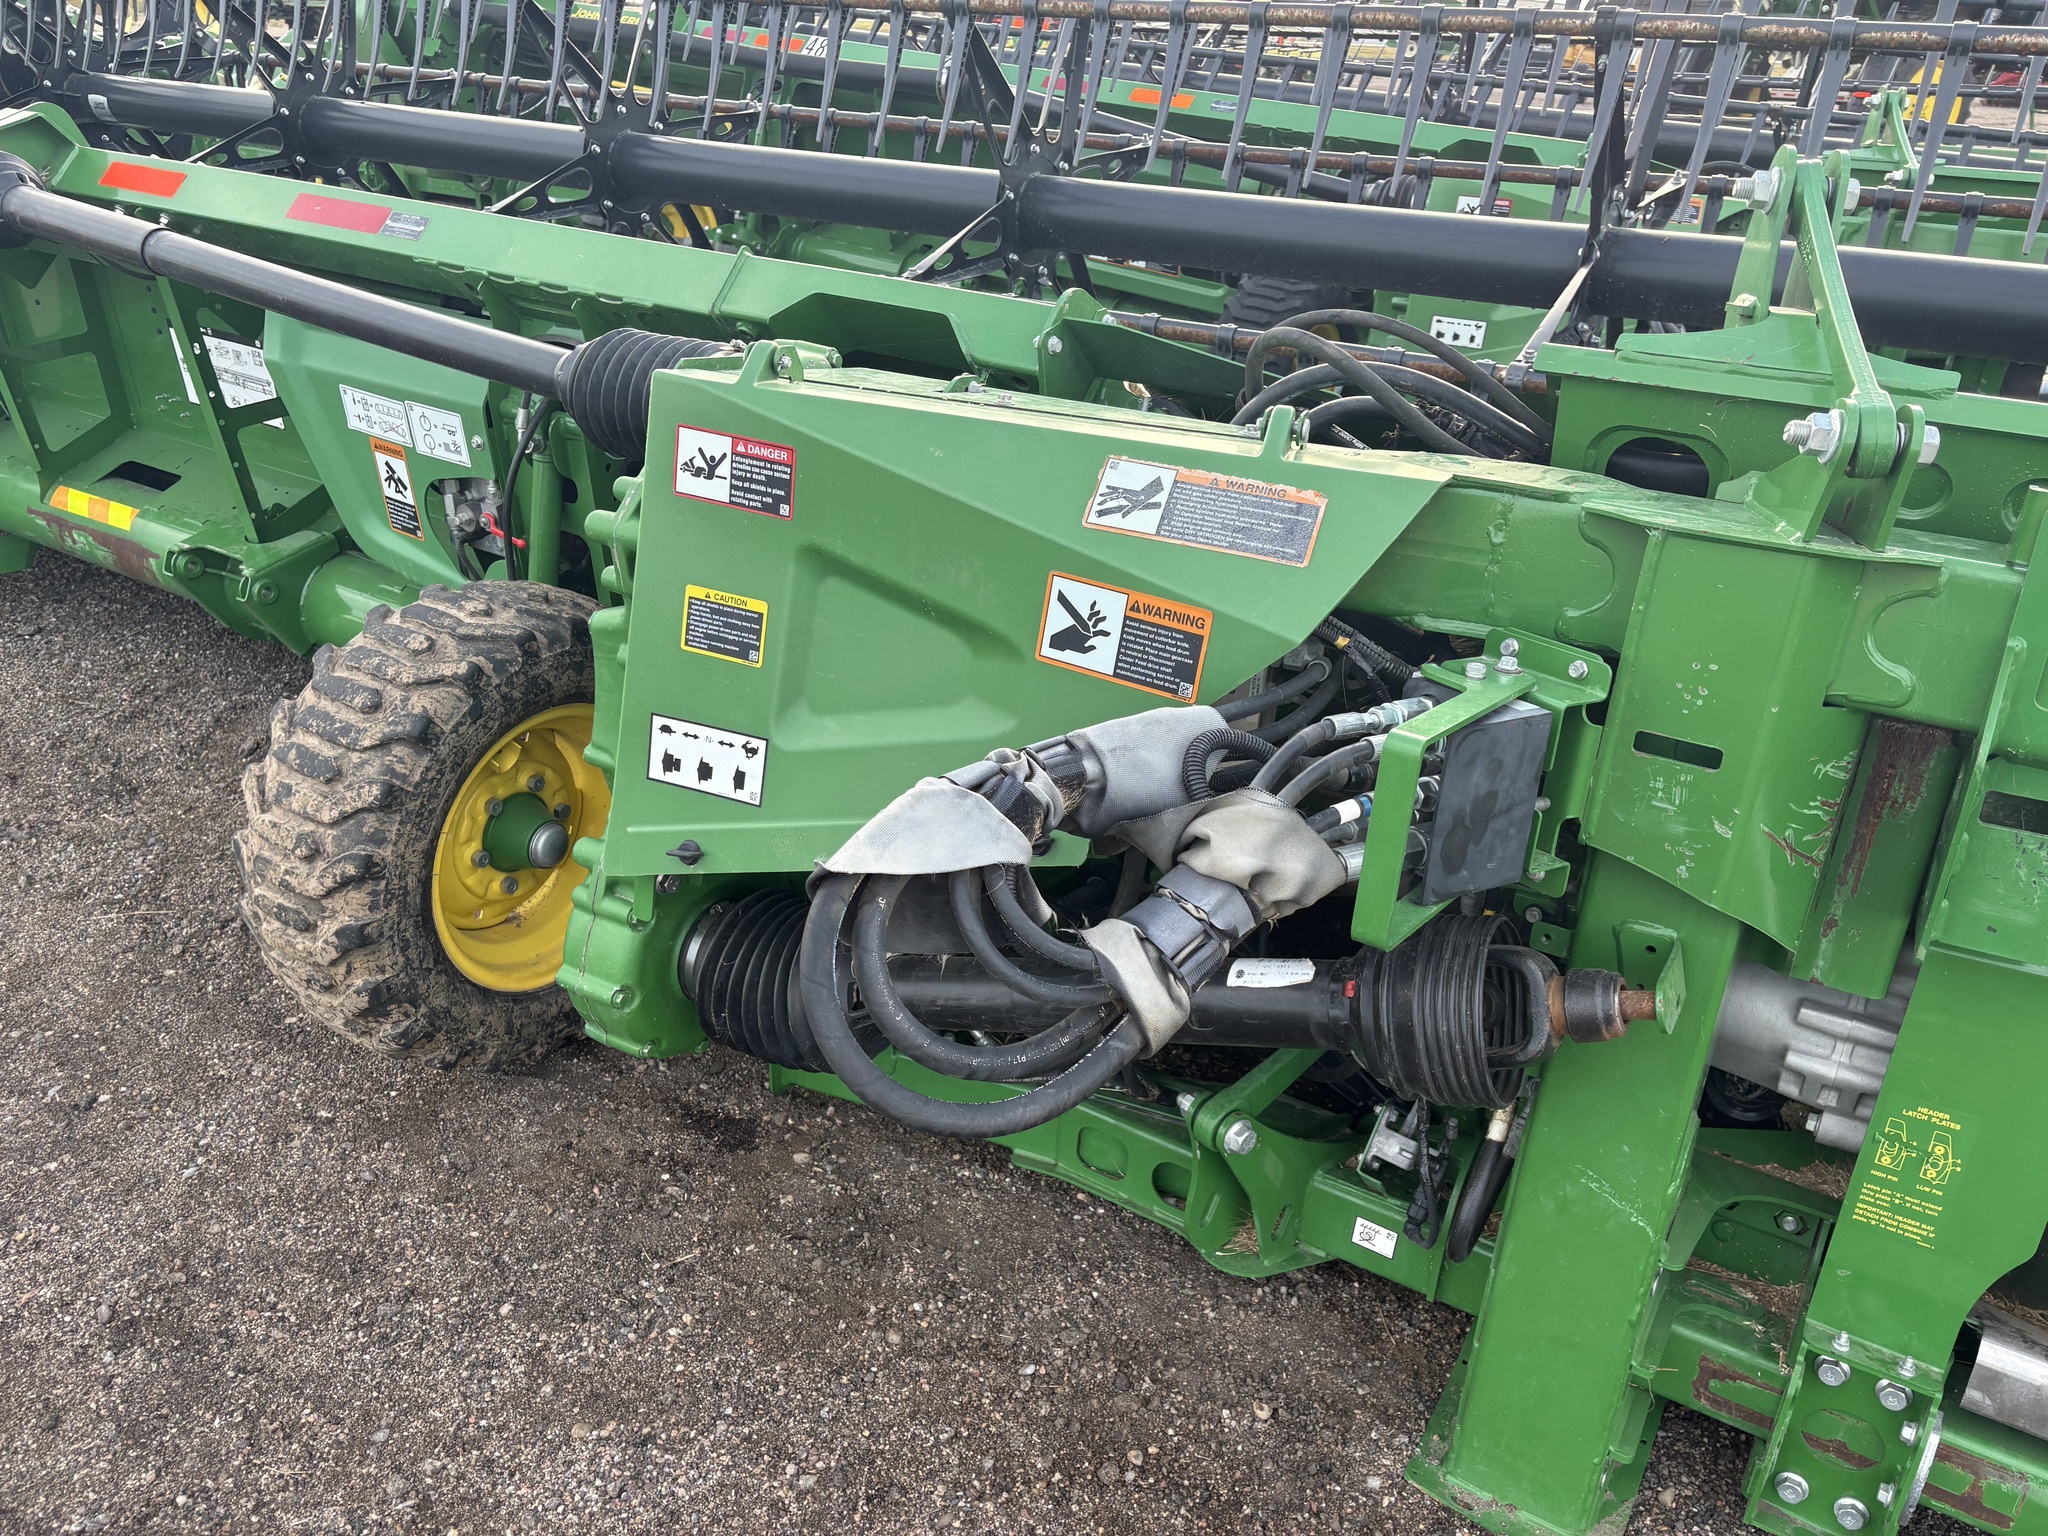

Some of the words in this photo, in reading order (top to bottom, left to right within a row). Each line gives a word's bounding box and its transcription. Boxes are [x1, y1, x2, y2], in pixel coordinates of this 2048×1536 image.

[747, 444, 788, 461] DANGER
[732, 462, 751, 471] driveline
[733, 455, 765, 467] Entanglement
[772, 464, 790, 474] rotating
[732, 469, 745, 477] injury
[752, 473, 767, 481] death.
[732, 479, 743, 487] Keep
[750, 483, 766, 491] shields
[772, 488, 786, 496] place.
[1226, 479, 1288, 499] WARNING
[731, 489, 744, 497] Avoid
[745, 493, 762, 501] contact
[731, 497, 748, 506] rotating
[714, 593, 748, 607] CAUTION
[1143, 603, 1205, 629] WARNING
[1124, 627, 1148, 637] movement
[1155, 636, 1176, 644] cutterbar
[1140, 624, 1157, 632] serious
[1158, 629, 1172, 637] injury
[1119, 654, 1134, 662] Center
[1149, 655, 1175, 666] Disconnect
[1171, 655, 1193, 664] gearcase
[1116, 669, 1145, 680] maintenance
[1130, 666, 1156, 677] performing
[1157, 673, 1174, 681] service
[1902, 1109, 1928, 1121] LATCH
[1931, 1117, 1961, 1130] PLATES
[1917, 1107, 1950, 1120] HEADER
[1871, 1170, 1886, 1178] HIGH
[1862, 1188, 1874, 1196] thru
[1875, 1193, 1891, 1201] plate
[1863, 1182, 1880, 1191] Latch
[1905, 1196, 1920, 1204] must
[1921, 1202, 1942, 1211] extend
[1876, 1200, 1890, 1208] over.
[1857, 1202, 1893, 1218] IMPORTANT:
[1894, 1215, 1920, 1227] HEADER
[1855, 1208, 1879, 1220] DETACH
[1880, 1217, 1898, 1226] FROM
[1899, 1223, 1928, 1236] COMBINE
[1904, 1232, 1922, 1241] place.
